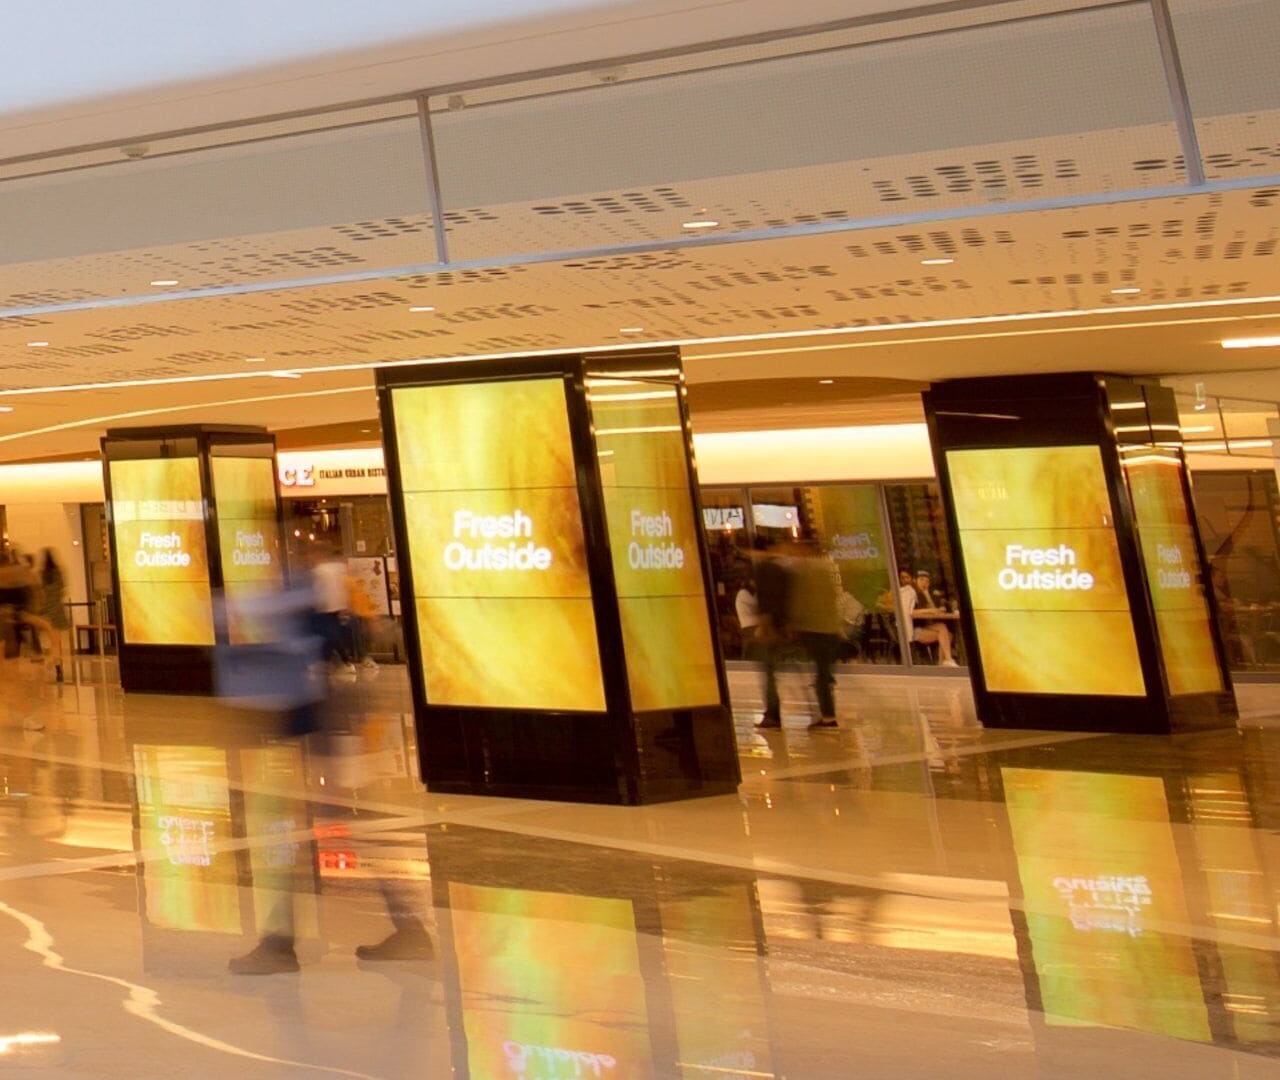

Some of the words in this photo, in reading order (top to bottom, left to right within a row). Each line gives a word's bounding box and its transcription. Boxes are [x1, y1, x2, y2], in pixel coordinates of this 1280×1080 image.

[453, 509, 533, 538] Fresh
[630, 509, 673, 537] Fresh
[140, 531, 181, 549] Fresh
[236, 530, 264, 548] Fresh
[135, 549, 191, 567] Outside
[232, 548, 271, 566] Outside
[443, 541, 553, 570] Outside
[627, 541, 684, 570] Outside
[1005, 543, 1076, 566] Fresh
[997, 567, 1094, 590] Outside
